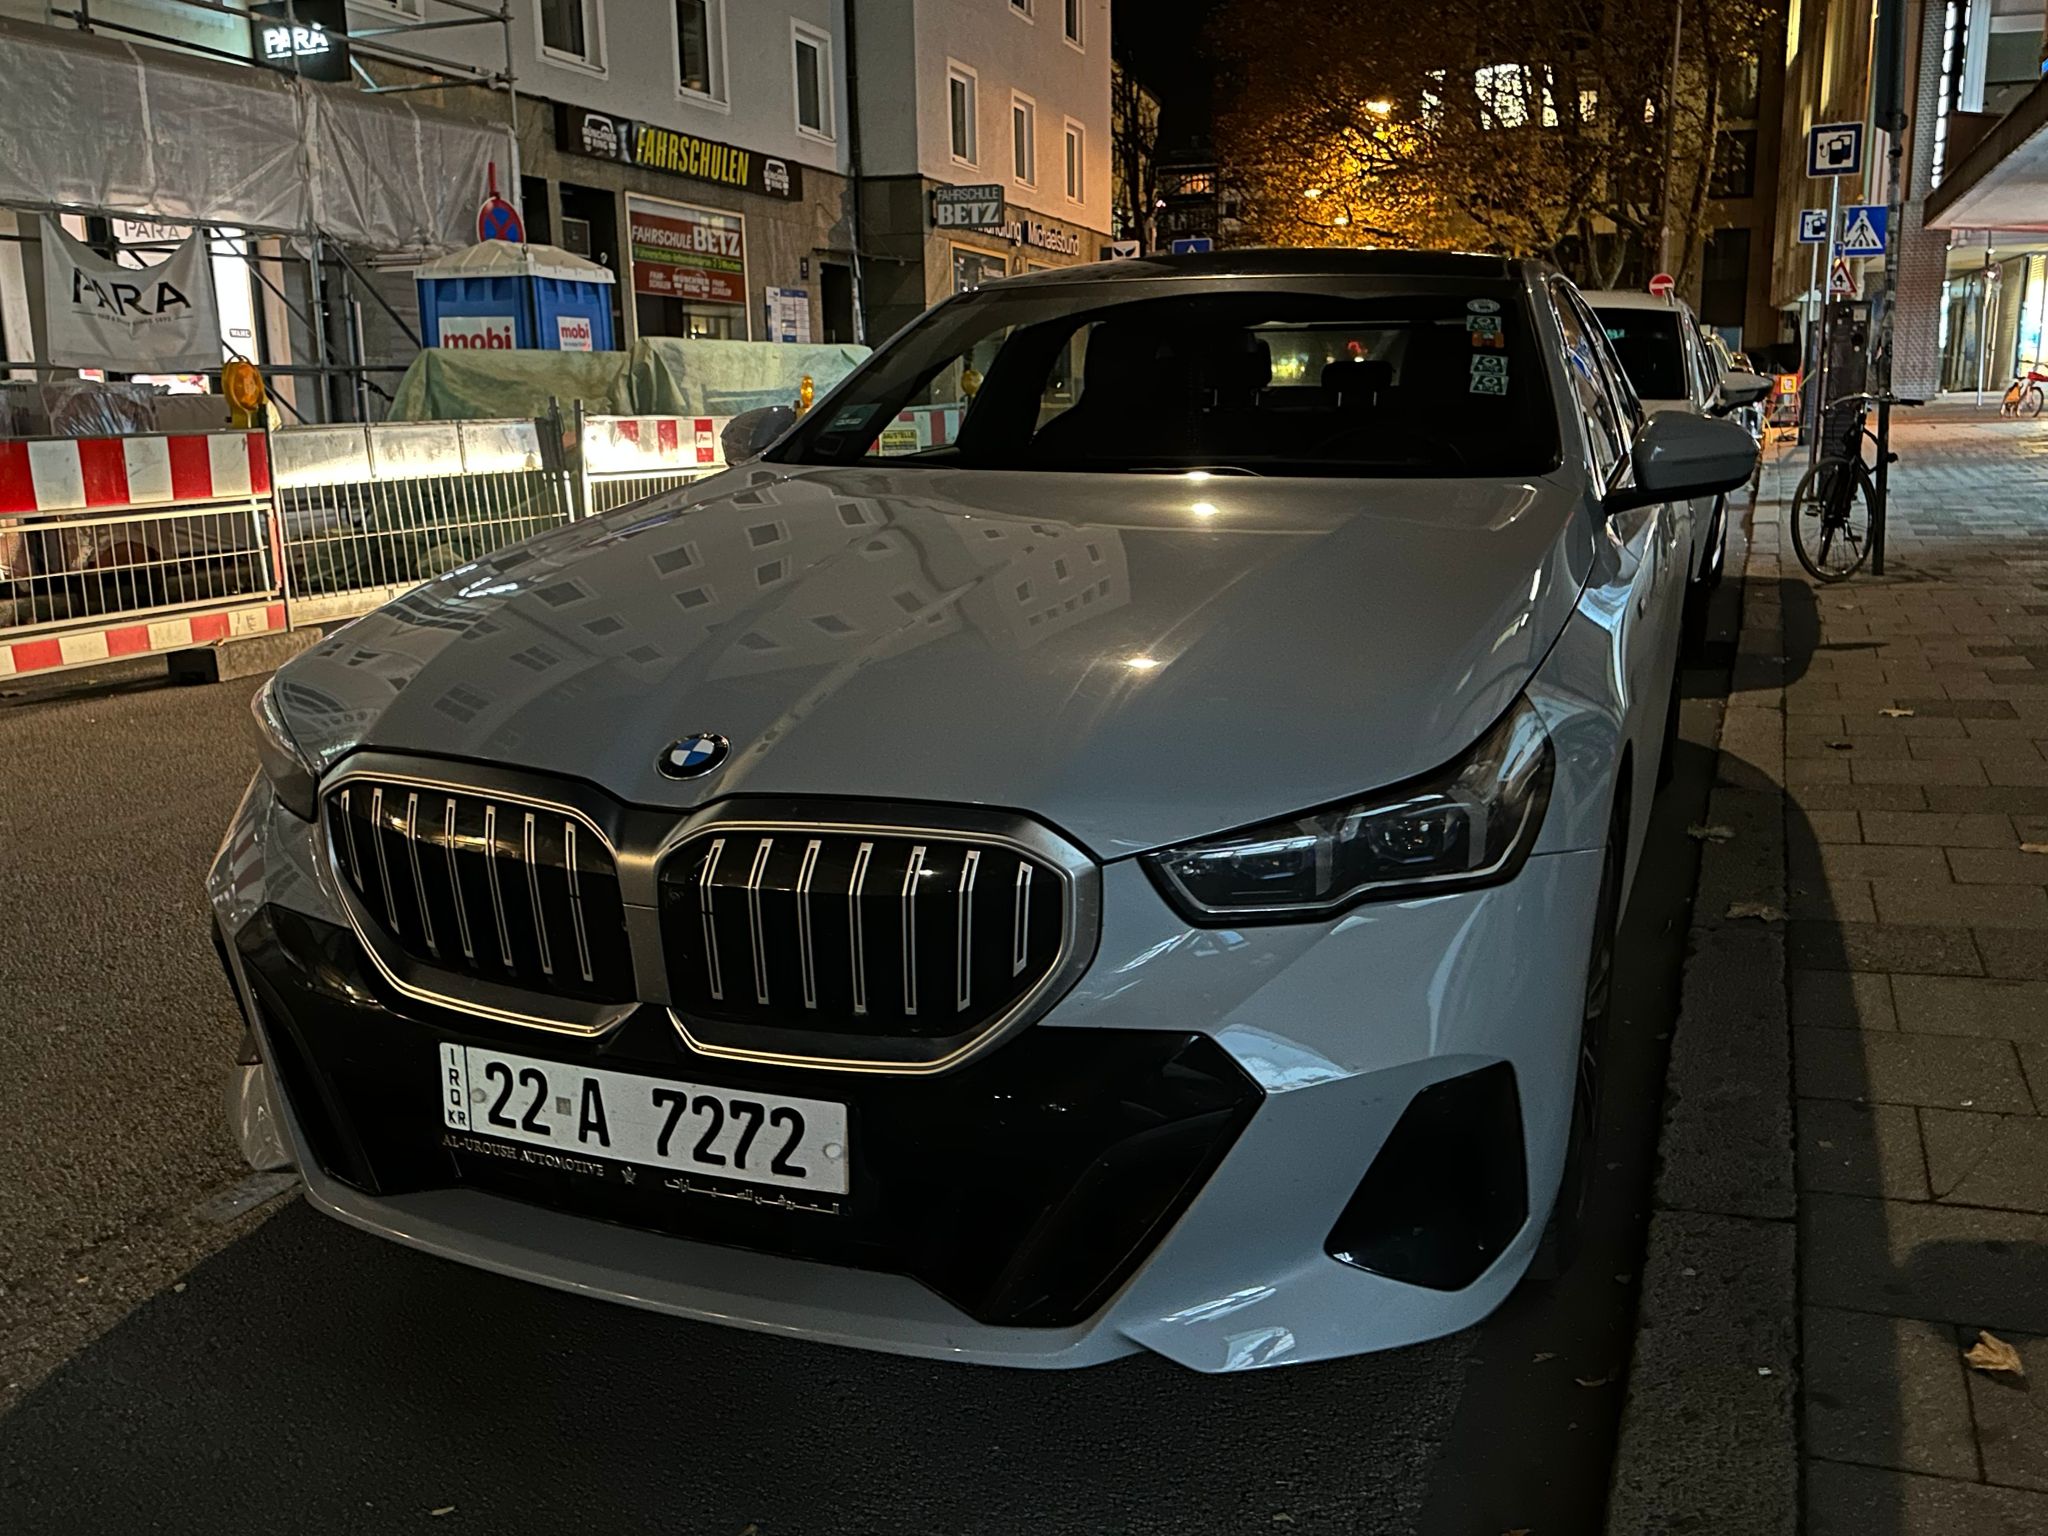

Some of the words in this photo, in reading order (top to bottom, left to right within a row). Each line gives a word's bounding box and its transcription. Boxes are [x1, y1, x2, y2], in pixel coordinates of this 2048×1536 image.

[262, 26, 329, 53] PARA
[636, 126, 750, 187] FAHRSCHULEN
[936, 186, 999, 200] FAHRSCHULE
[937, 201, 999, 226] BETZ
[124, 221, 180, 240] PARA
[631, 224, 692, 249] FAHRSCHULE
[692, 225, 740, 257] BETZ
[1027, 220, 1080, 256] Michaelsbund
[443, 325, 512, 350] mobi
[560, 323, 590, 339] mobi
[447, 1109, 467, 1126] KR
[485, 1061, 551, 1137] 22
[578, 1077, 611, 1148] A
[652, 1087, 807, 1179] 7272
[442, 1133, 517, 1160] AL-UROUSH
[519, 1149, 605, 1177] AUTOMOTIVE
